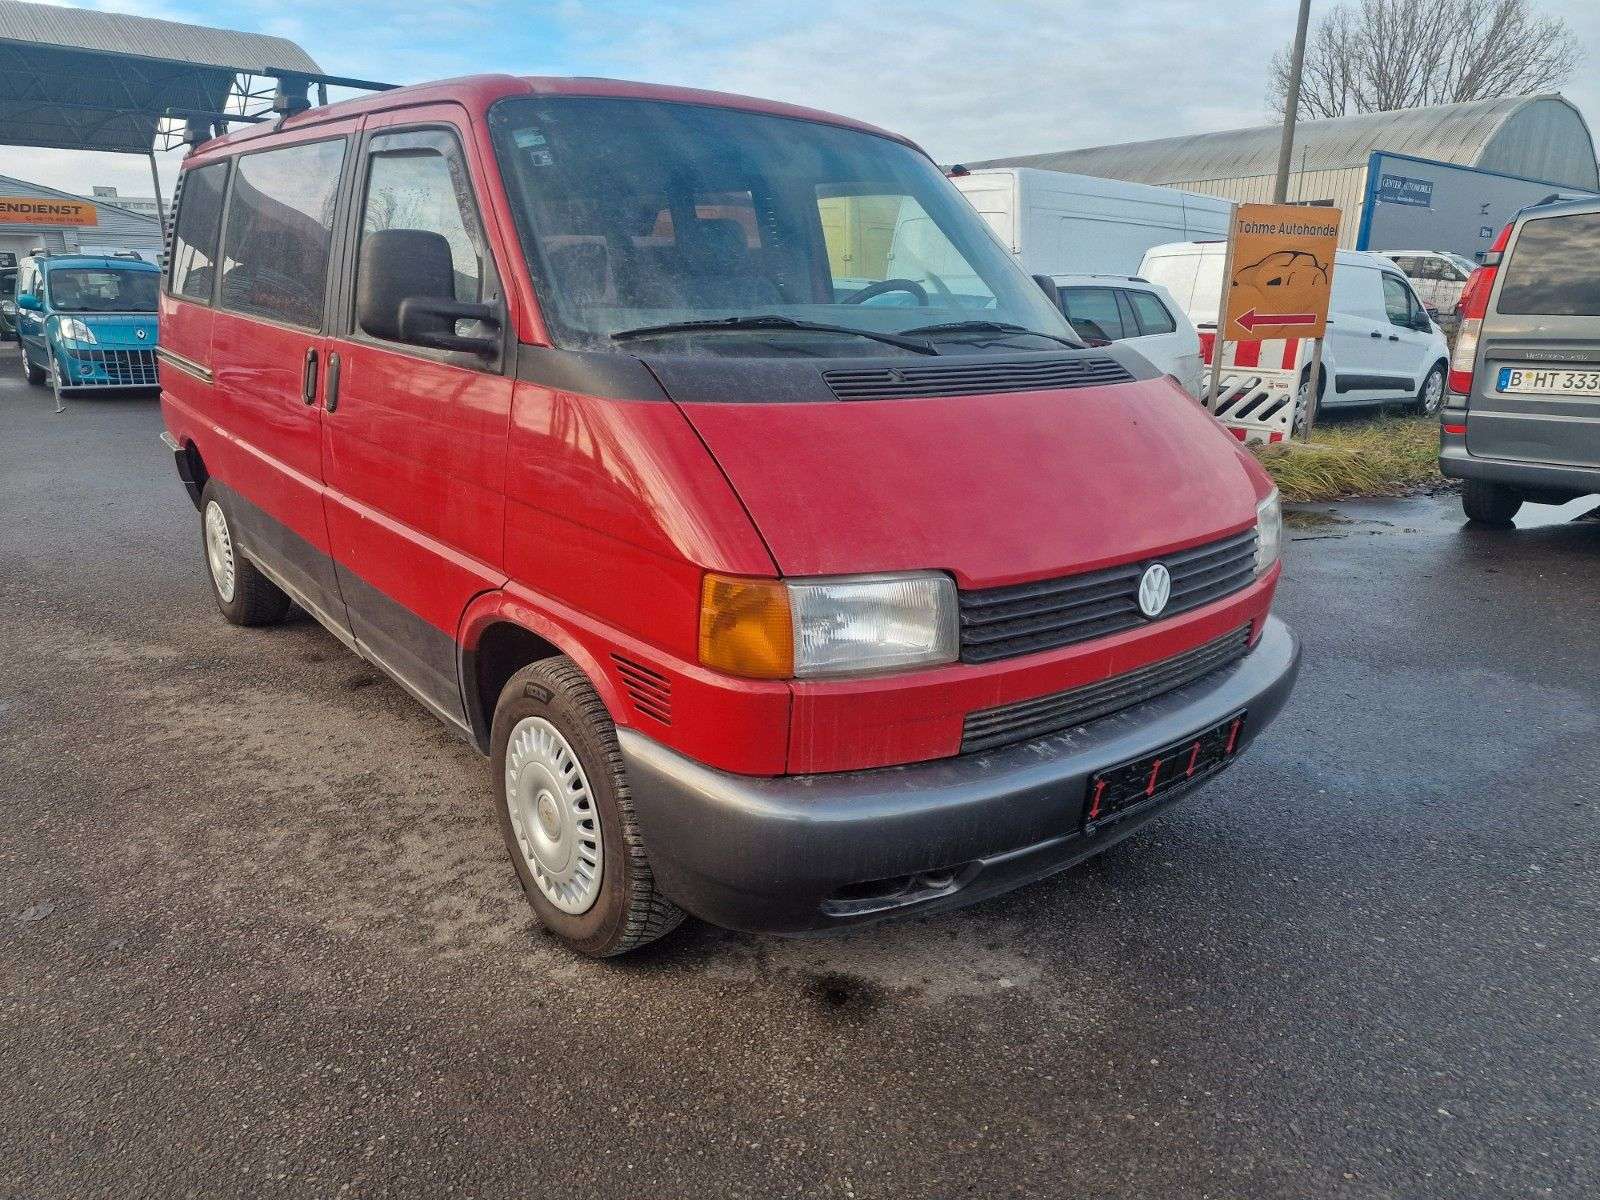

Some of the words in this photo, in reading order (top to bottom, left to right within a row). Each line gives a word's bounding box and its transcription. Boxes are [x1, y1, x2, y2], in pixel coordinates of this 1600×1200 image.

[1239, 220, 1276, 234] Tohme
[1279, 222, 1339, 236] Autohandel
[1510, 371, 1523, 387] B
[1533, 372, 1560, 388] HT
[1562, 373, 1600, 390] 333
